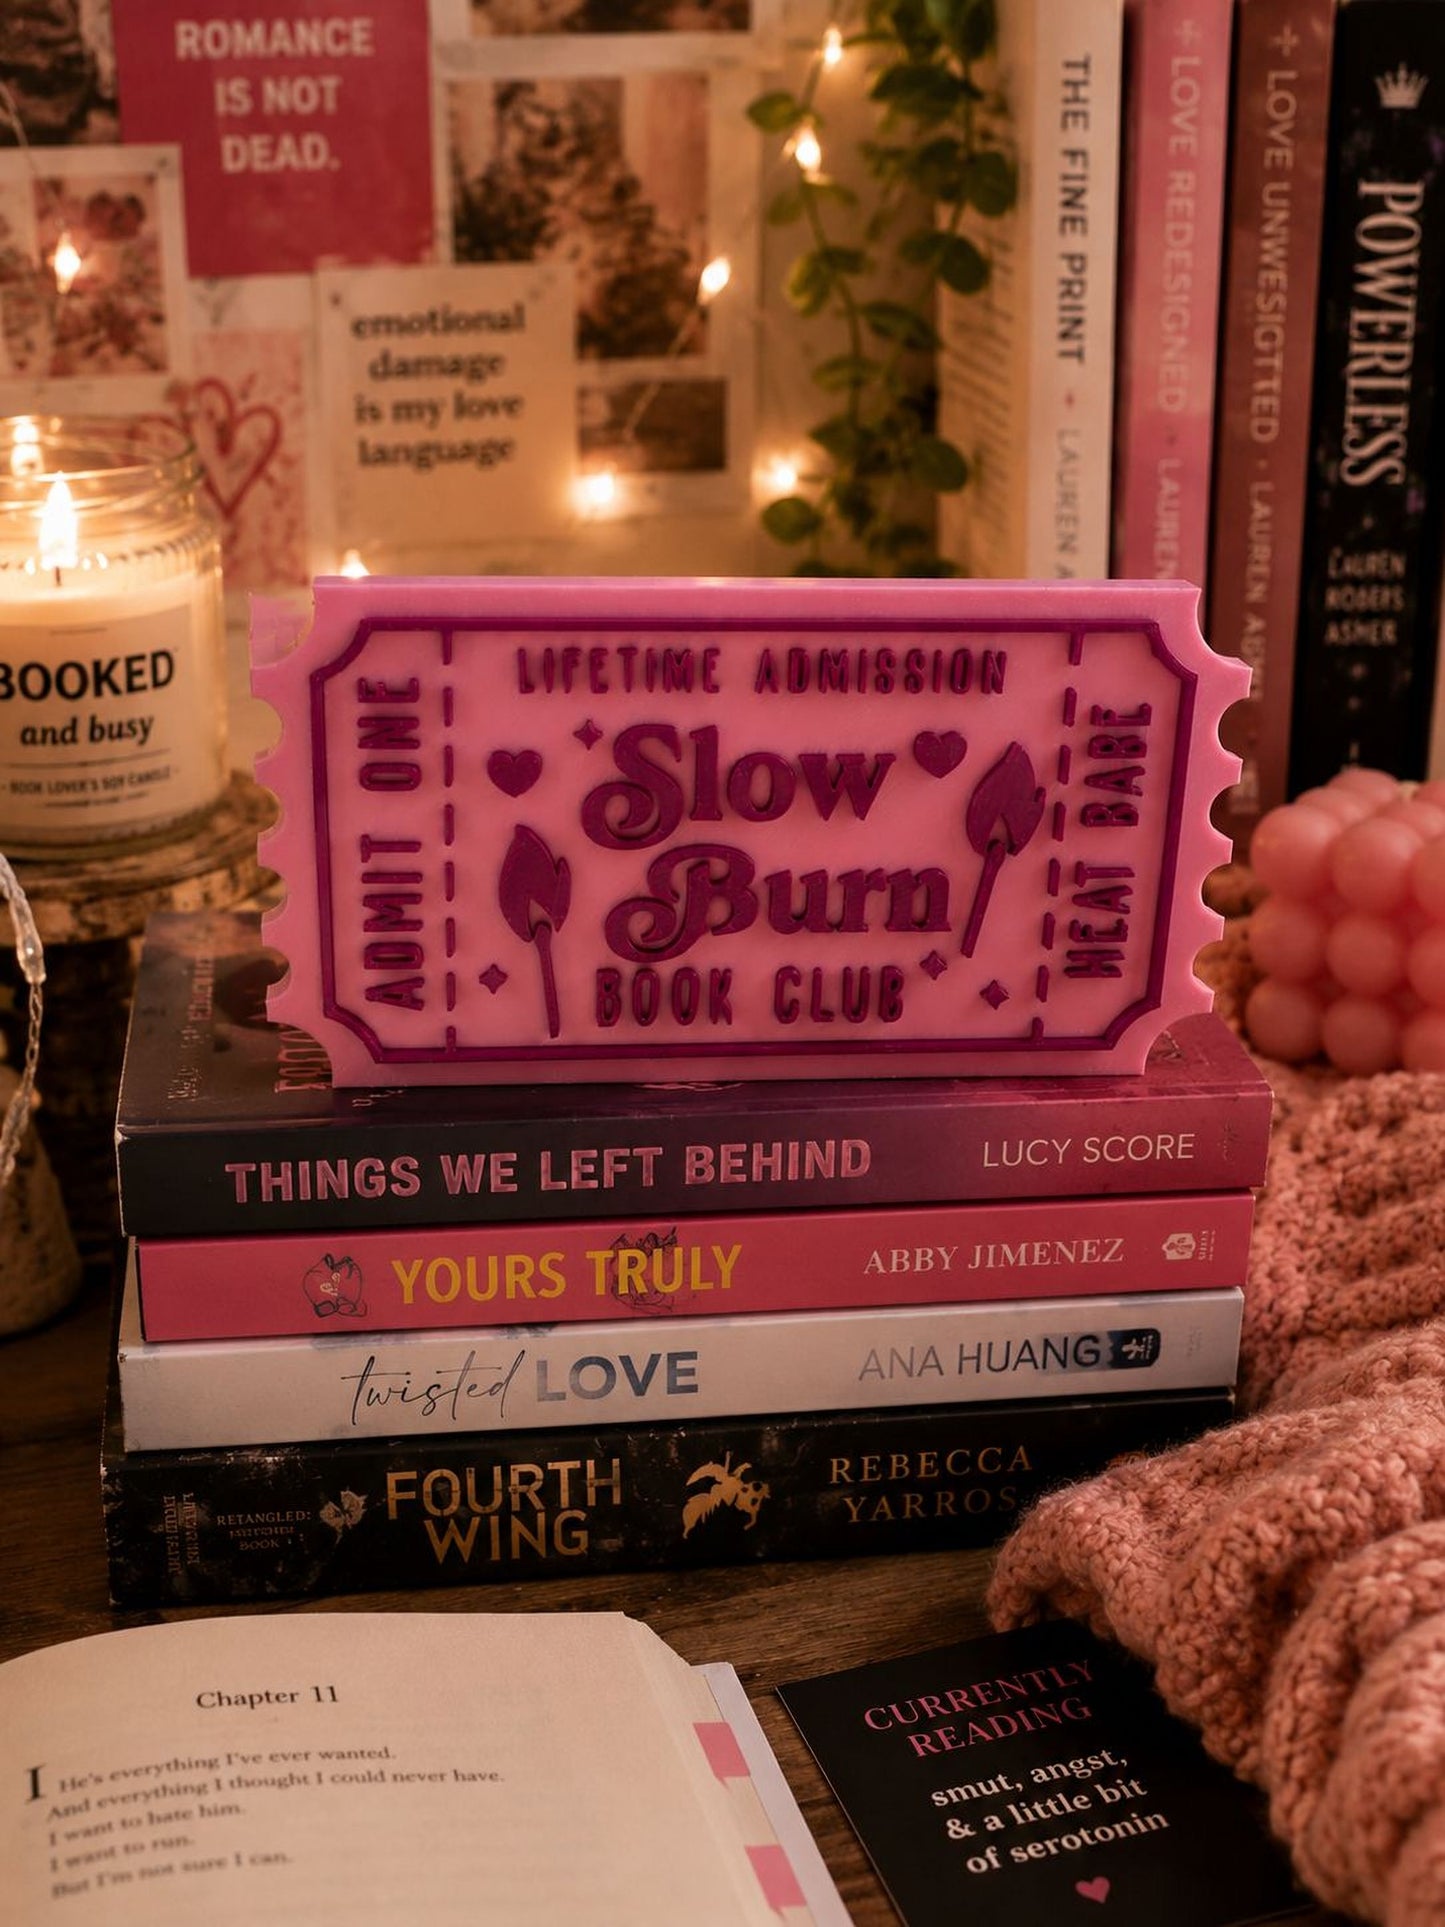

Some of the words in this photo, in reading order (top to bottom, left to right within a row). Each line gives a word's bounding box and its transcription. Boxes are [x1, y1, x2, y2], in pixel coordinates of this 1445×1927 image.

[175, 18, 374, 60] ROMANCE
[216, 77, 252, 117] IS
[262, 76, 342, 116] NOT
[1061, 52, 1091, 131] THE
[1169, 56, 1201, 156] LOVE
[1264, 70, 1298, 168] LOVE
[222, 133, 340, 173] DEAD.
[1058, 148, 1088, 238] FINE
[352, 305, 525, 338] emotional
[1057, 252, 1087, 367] PRINT
[1157, 170, 1196, 414] REDESIGNED
[1340, 181, 1425, 487] POWERLESS
[369, 349, 505, 381] damage
[355, 396, 382, 423] is
[393, 401, 443, 428] my
[454, 393, 523, 419] love
[358, 437, 516, 471] language
[1055, 428, 1081, 555] LAUREN
[1244, 481, 1275, 602] LAUREN
[517, 647, 721, 694] LIFETIME
[754, 647, 1007, 695] ADMISSION
[20, 717, 78, 746] and
[88, 713, 155, 745] busy
[357, 677, 422, 792] ONE
[580, 723, 897, 850] Slow
[1080, 702, 1152, 827] BABE
[361, 834, 425, 1011] ADMIT
[604, 843, 952, 963] Burn
[1064, 860, 1136, 979] HEAT
[596, 966, 733, 1027] BOOK
[773, 964, 905, 1024] CLUB
[225, 1156, 422, 1203] THINGS
[440, 1152, 518, 1195] WE
[539, 1146, 663, 1191] LEFT
[684, 1138, 872, 1185] BEHIND
[983, 1138, 1072, 1168] LUCY
[1083, 1133, 1196, 1163] SCORE
[391, 1252, 567, 1304] YOURS
[586, 1243, 742, 1297] TRULY
[863, 1247, 959, 1275] ABBY
[967, 1238, 1125, 1270] JIMENEZ
[340, 1350, 526, 1426] twisted
[536, 1350, 699, 1401] LOVE
[858, 1345, 944, 1381] ANA
[957, 1334, 1102, 1376] HUANG
[386, 1458, 622, 1520] FOURTH
[829, 1445, 1032, 1484] REBECCA
[844, 1486, 1017, 1524] YARROS
[423, 1508, 590, 1566] WING
[195, 1686, 300, 1711] Chapter
[311, 1685, 339, 1703] 11
[863, 1659, 1095, 1732] CURRENTLY
[908, 1697, 1093, 1758] READING
[48, 1798, 91, 1822] And
[97, 1780, 209, 1809] everything
[215, 1777, 224, 1792] I
[229, 1770, 309, 1792] thought
[315, 1771, 324, 1785] I
[329, 1769, 387, 1786] could
[392, 1771, 448, 1785] never
[453, 1768, 506, 1784] have.
[58, 1771, 104, 1794] He's
[109, 1756, 220, 1780] everything
[226, 1751, 263, 1766] I've
[269, 1749, 312, 1764] ever
[318, 1745, 397, 1761] wanted.
[930, 1772, 1024, 1808] smut,
[1030, 1748, 1129, 1784] angst,
[50, 1831, 58, 1847] I
[63, 1820, 114, 1843] want
[120, 1816, 143, 1831] to
[148, 1809, 193, 1827] hate
[198, 1802, 248, 1820] him.
[946, 1816, 977, 1841] &
[984, 1815, 1006, 1832] a
[1006, 1792, 1093, 1827] little
[1099, 1776, 1149, 1806] bit
[50, 1856, 59, 1874] I
[65, 1847, 116, 1870] want
[123, 1842, 146, 1855] to
[152, 1835, 196, 1852] run.
[965, 1846, 1002, 1874] of
[1009, 1809, 1171, 1864] serotonin
[52, 1878, 91, 1899] But
[96, 1868, 134, 1889] I'm
[138, 1862, 175, 1882] not
[181, 1857, 228, 1873] sure
[234, 1852, 243, 1868] I
[250, 1850, 295, 1867] can.
